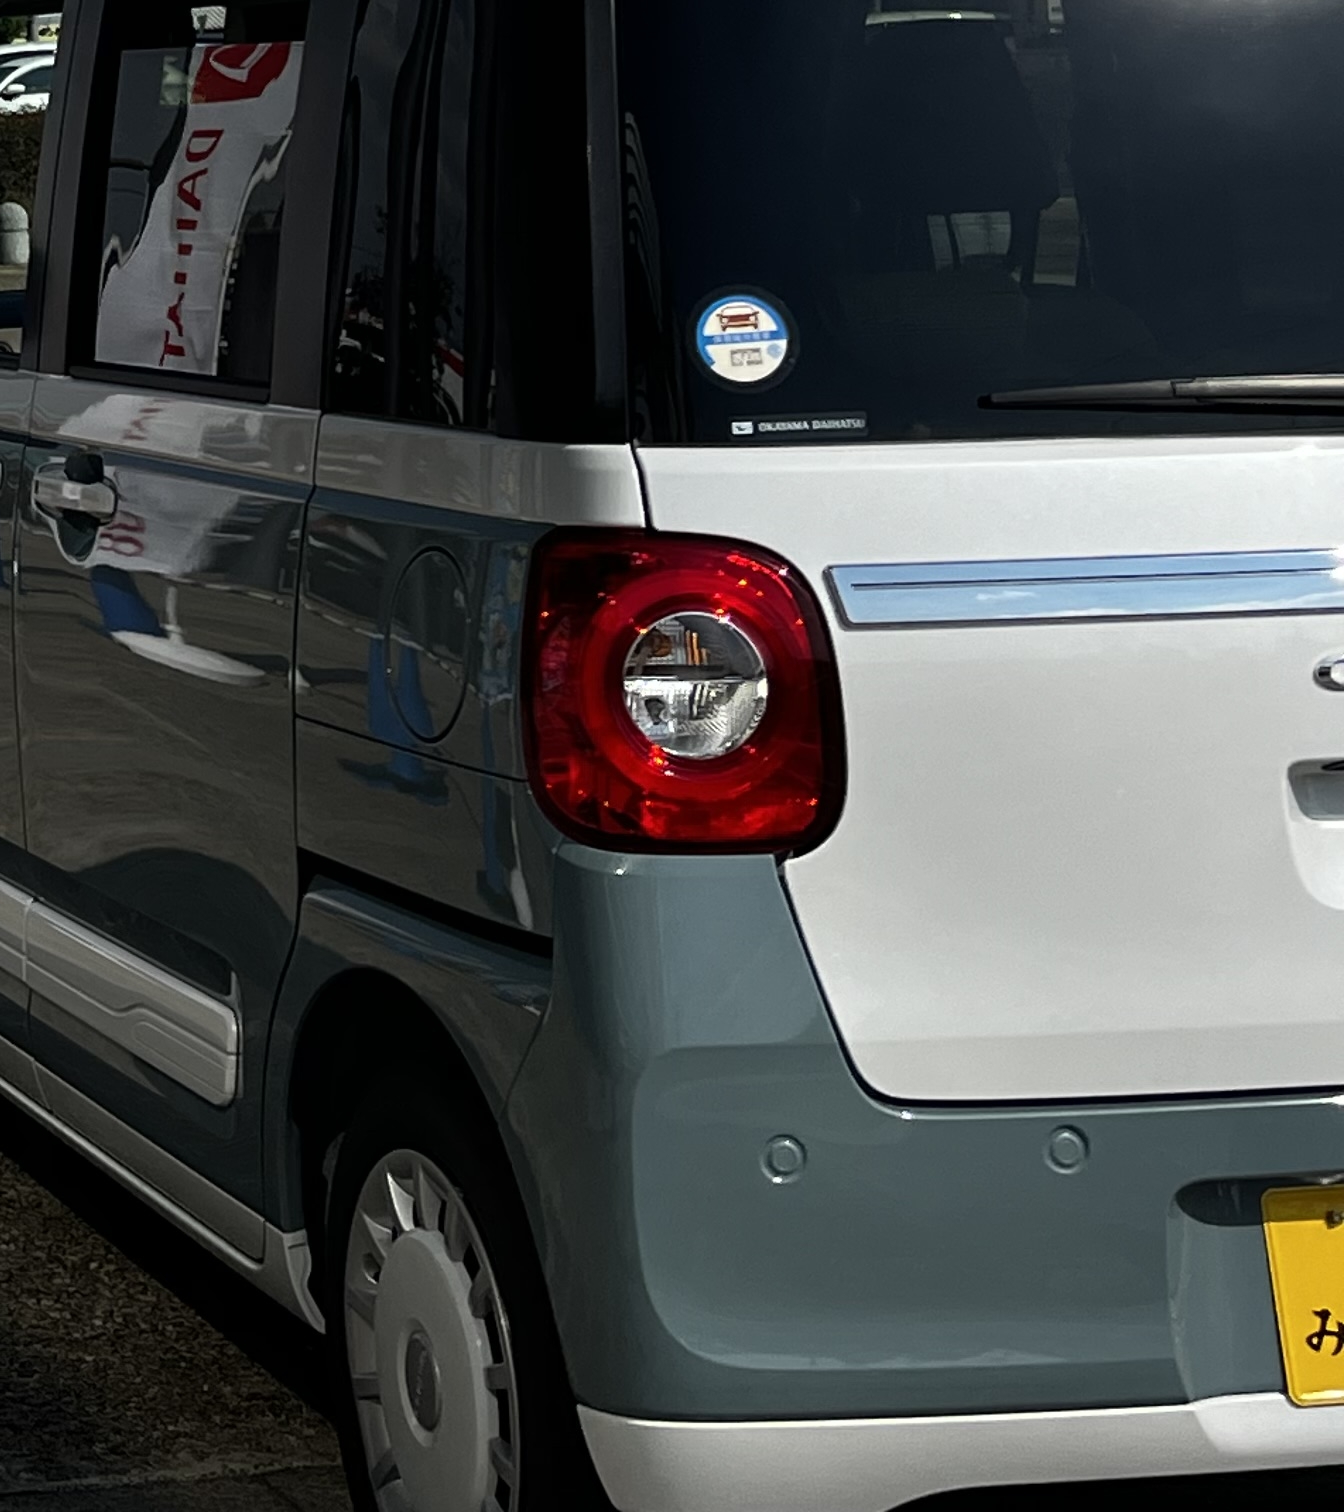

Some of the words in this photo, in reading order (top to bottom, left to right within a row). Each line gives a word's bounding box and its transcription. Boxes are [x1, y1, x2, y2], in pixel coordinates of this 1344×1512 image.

[758, 421, 809, 433] OKAYAMA
[811, 418, 865, 430] DAIHATSU
[1306, 1308, 1344, 1356] み
